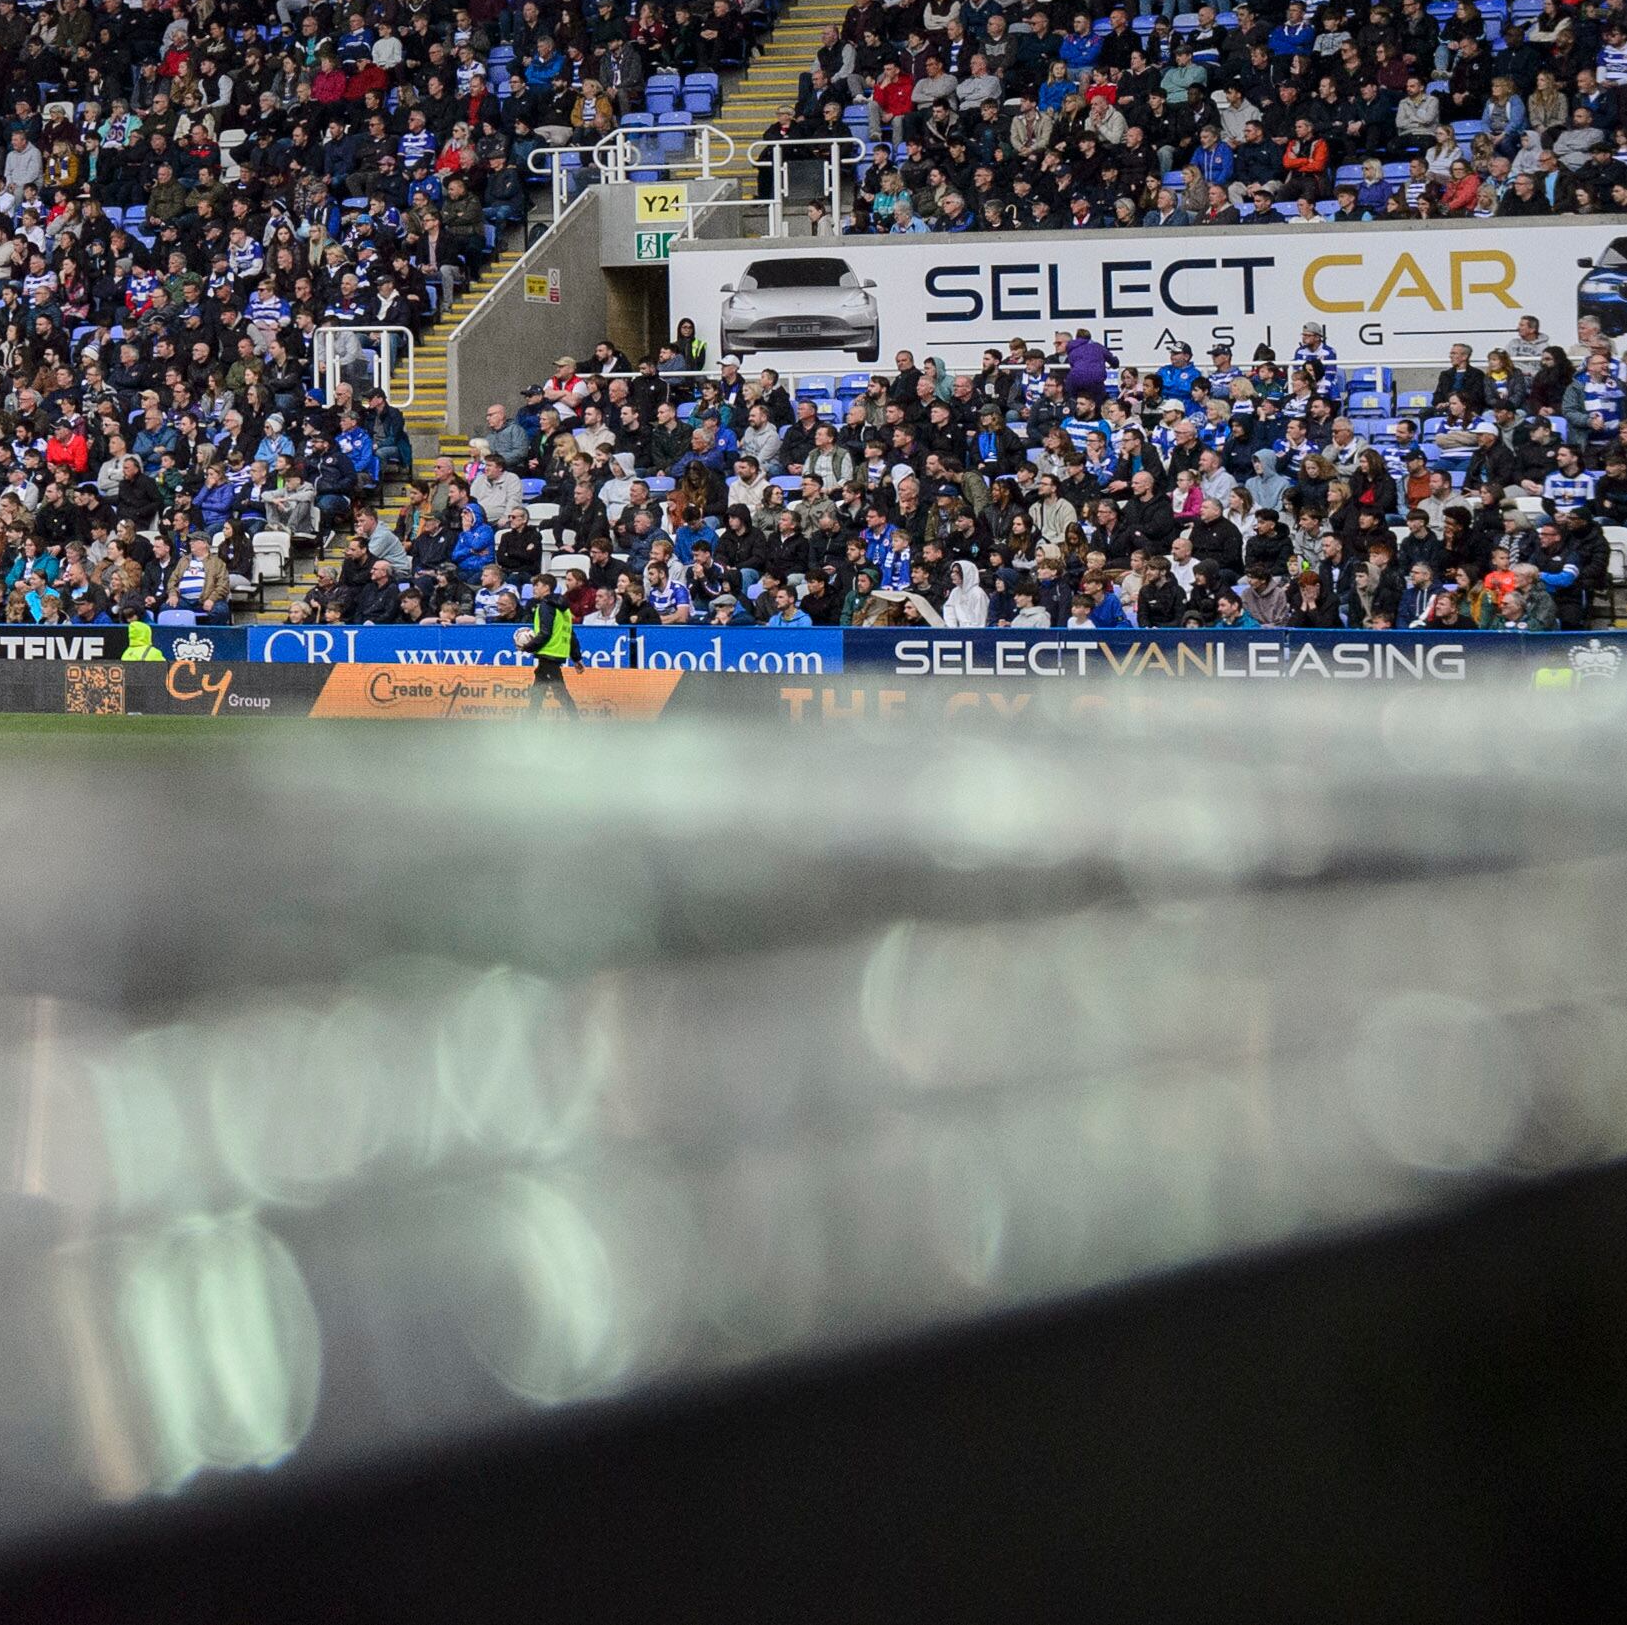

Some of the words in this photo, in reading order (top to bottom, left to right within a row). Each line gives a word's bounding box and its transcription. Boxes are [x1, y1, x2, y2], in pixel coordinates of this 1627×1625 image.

[642, 195, 680, 213] Y24
[924, 256, 1276, 322] SELECT
[1302, 249, 1524, 314] CAR
[895, 640, 1466, 680] SELECTVANLEASING
[228, 694, 272, 710] Group
[369, 672, 434, 704] Create
